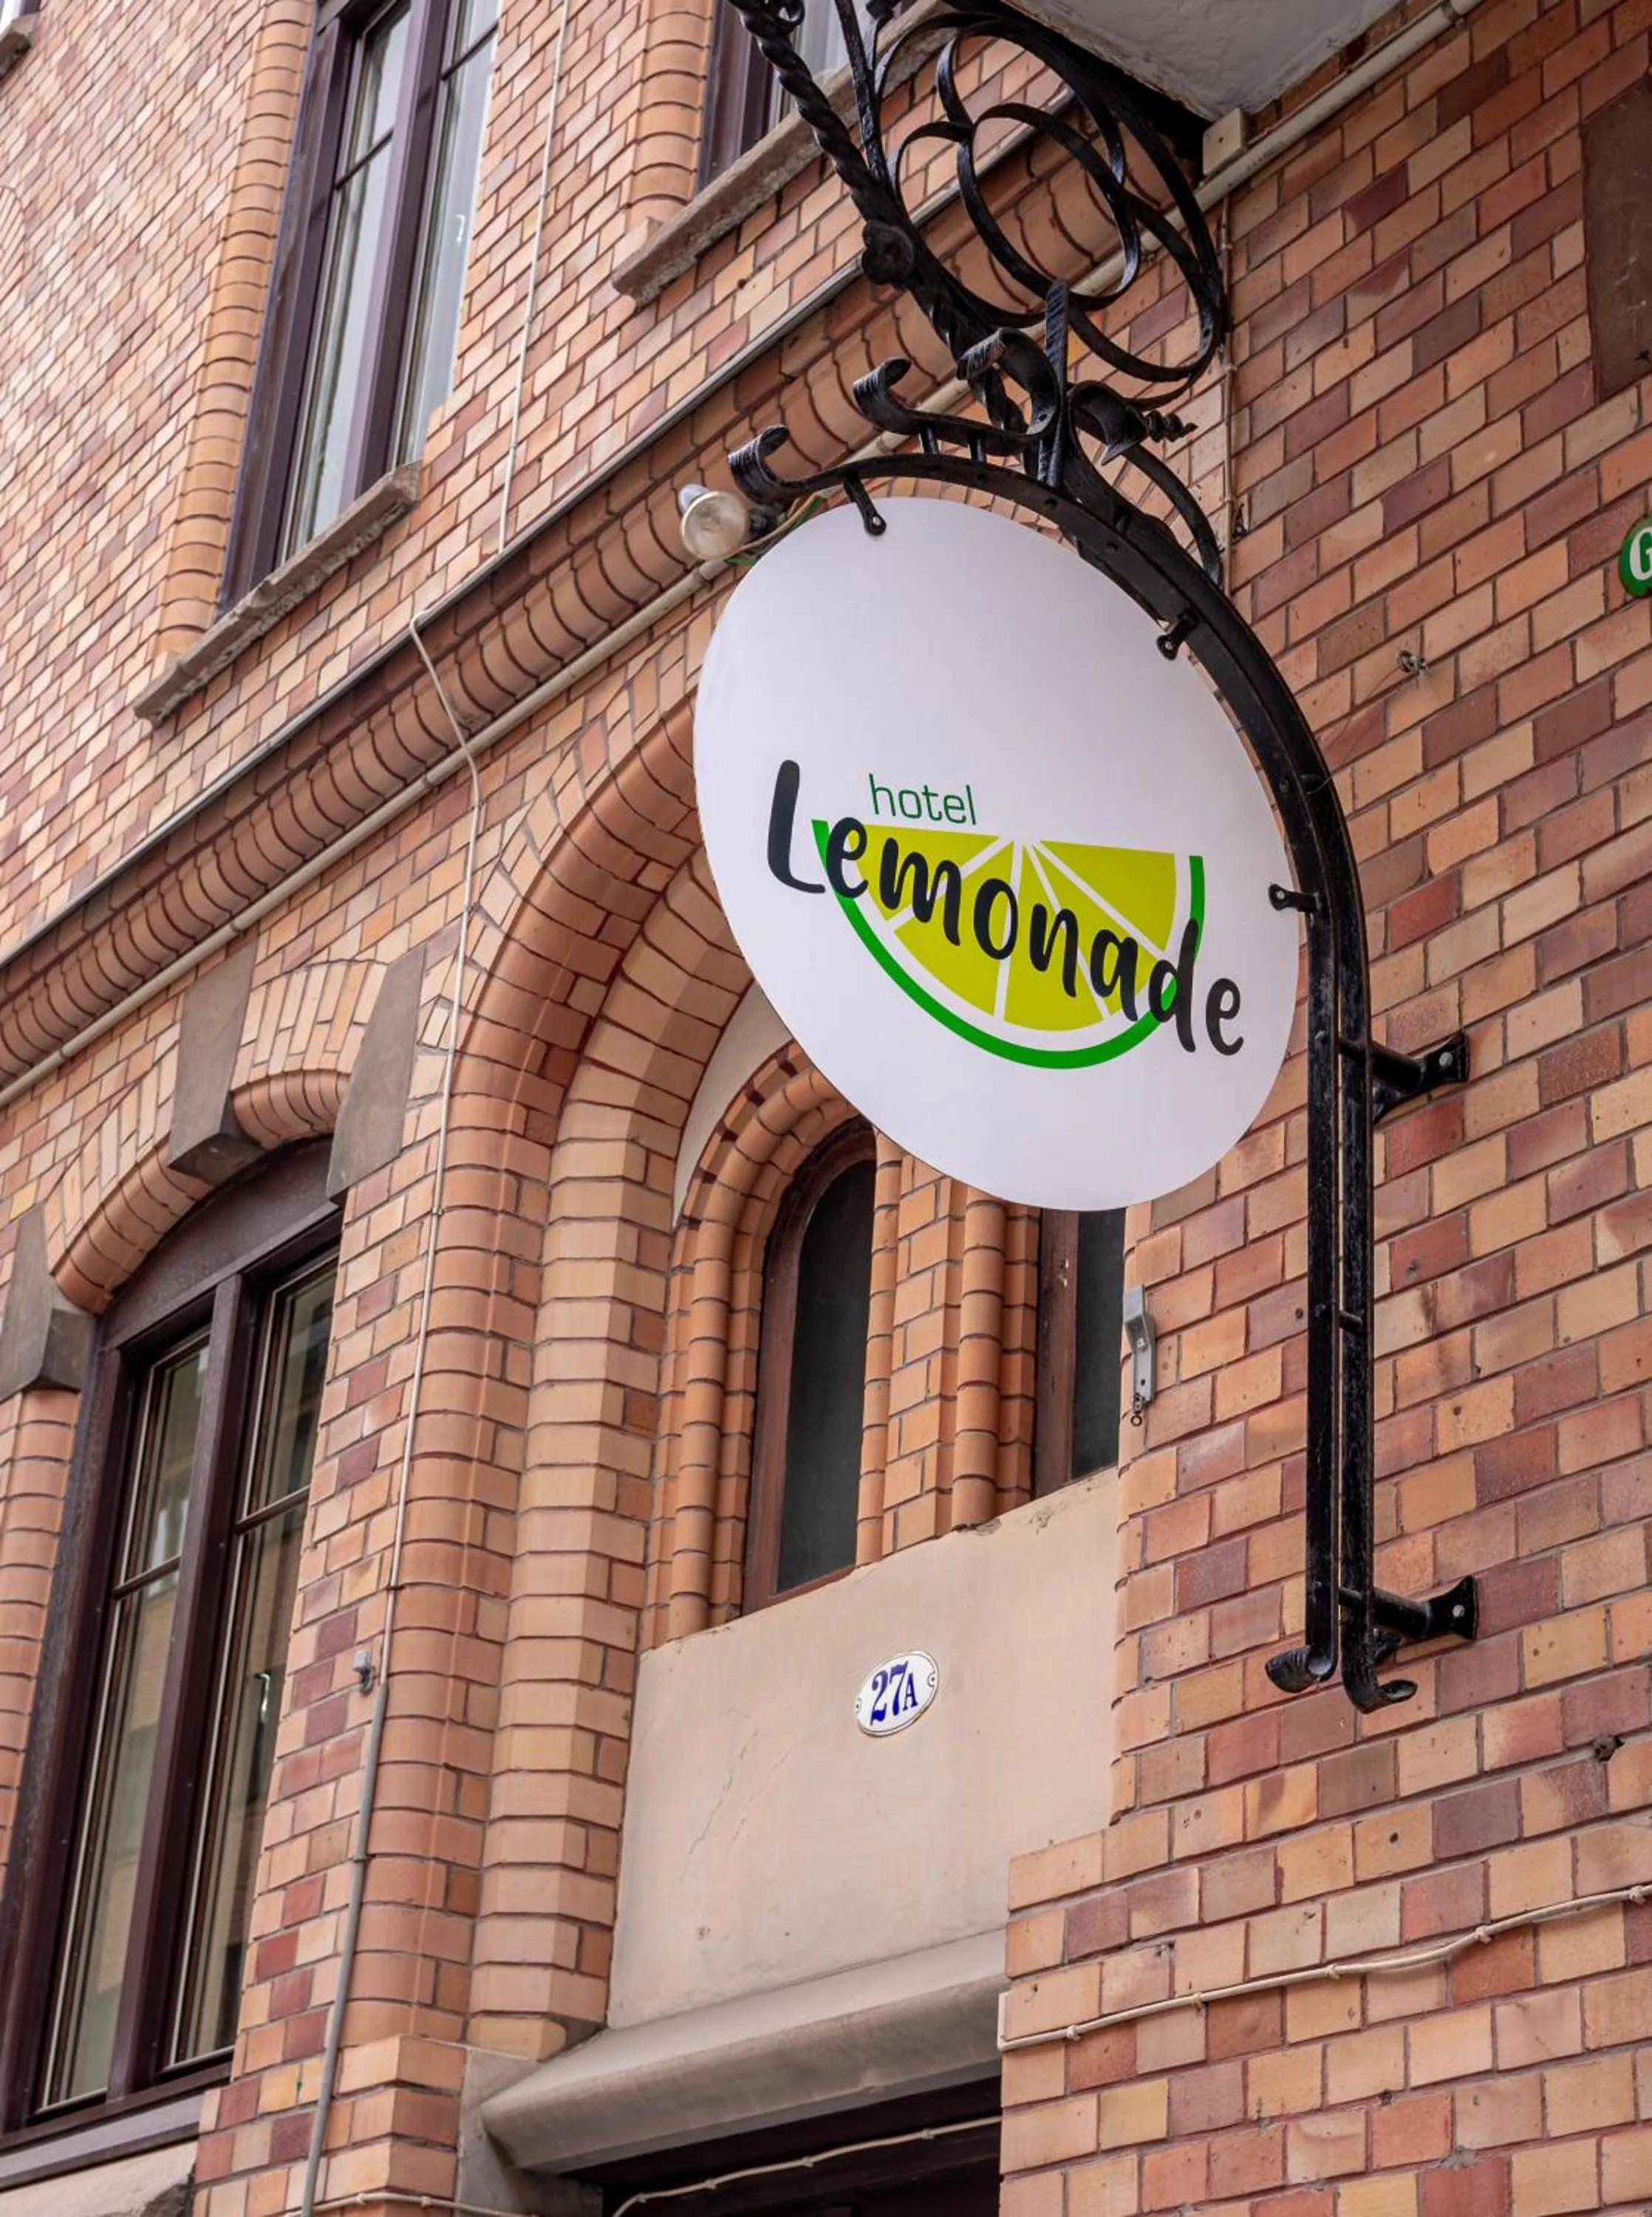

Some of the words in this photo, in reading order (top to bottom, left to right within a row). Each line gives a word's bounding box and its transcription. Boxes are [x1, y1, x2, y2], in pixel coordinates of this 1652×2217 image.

[868, 773, 977, 825] hotel
[767, 759, 1244, 1056] Lemonade
[870, 1661, 918, 1726] 27A
